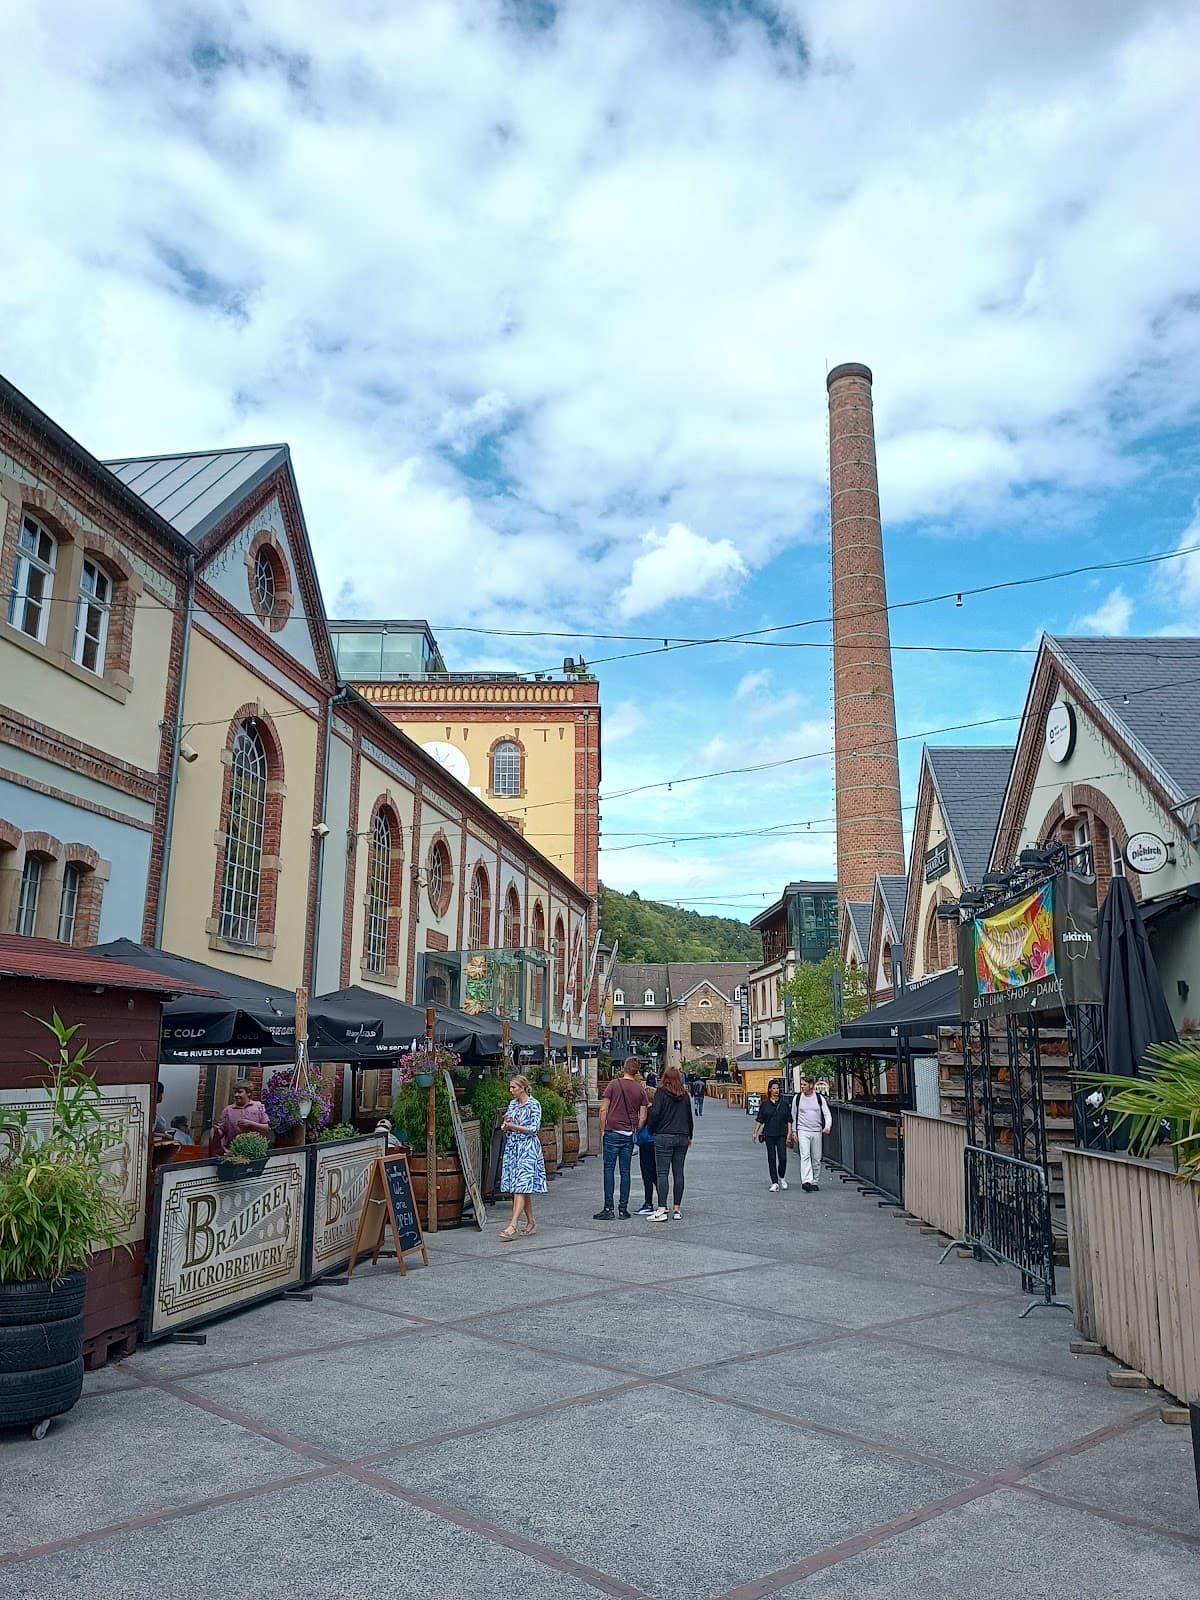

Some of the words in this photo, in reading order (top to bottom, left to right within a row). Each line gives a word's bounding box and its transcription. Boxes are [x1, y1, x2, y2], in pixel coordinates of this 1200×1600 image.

[1062, 930, 1092, 943] kirch
[973, 997, 985, 1009] EAT
[1007, 986, 1029, 1001] SHOP
[1037, 978, 1064, 996] DANCE
[173, 1028, 206, 1038] COLD
[190, 1049, 212, 1057] RIVES
[225, 1047, 262, 1056] CLAUSEN
[325, 1163, 374, 1226] BRAUER
[181, 1181, 289, 1269] BRAUEREI
[178, 1244, 285, 1294] MICROBREWERY
